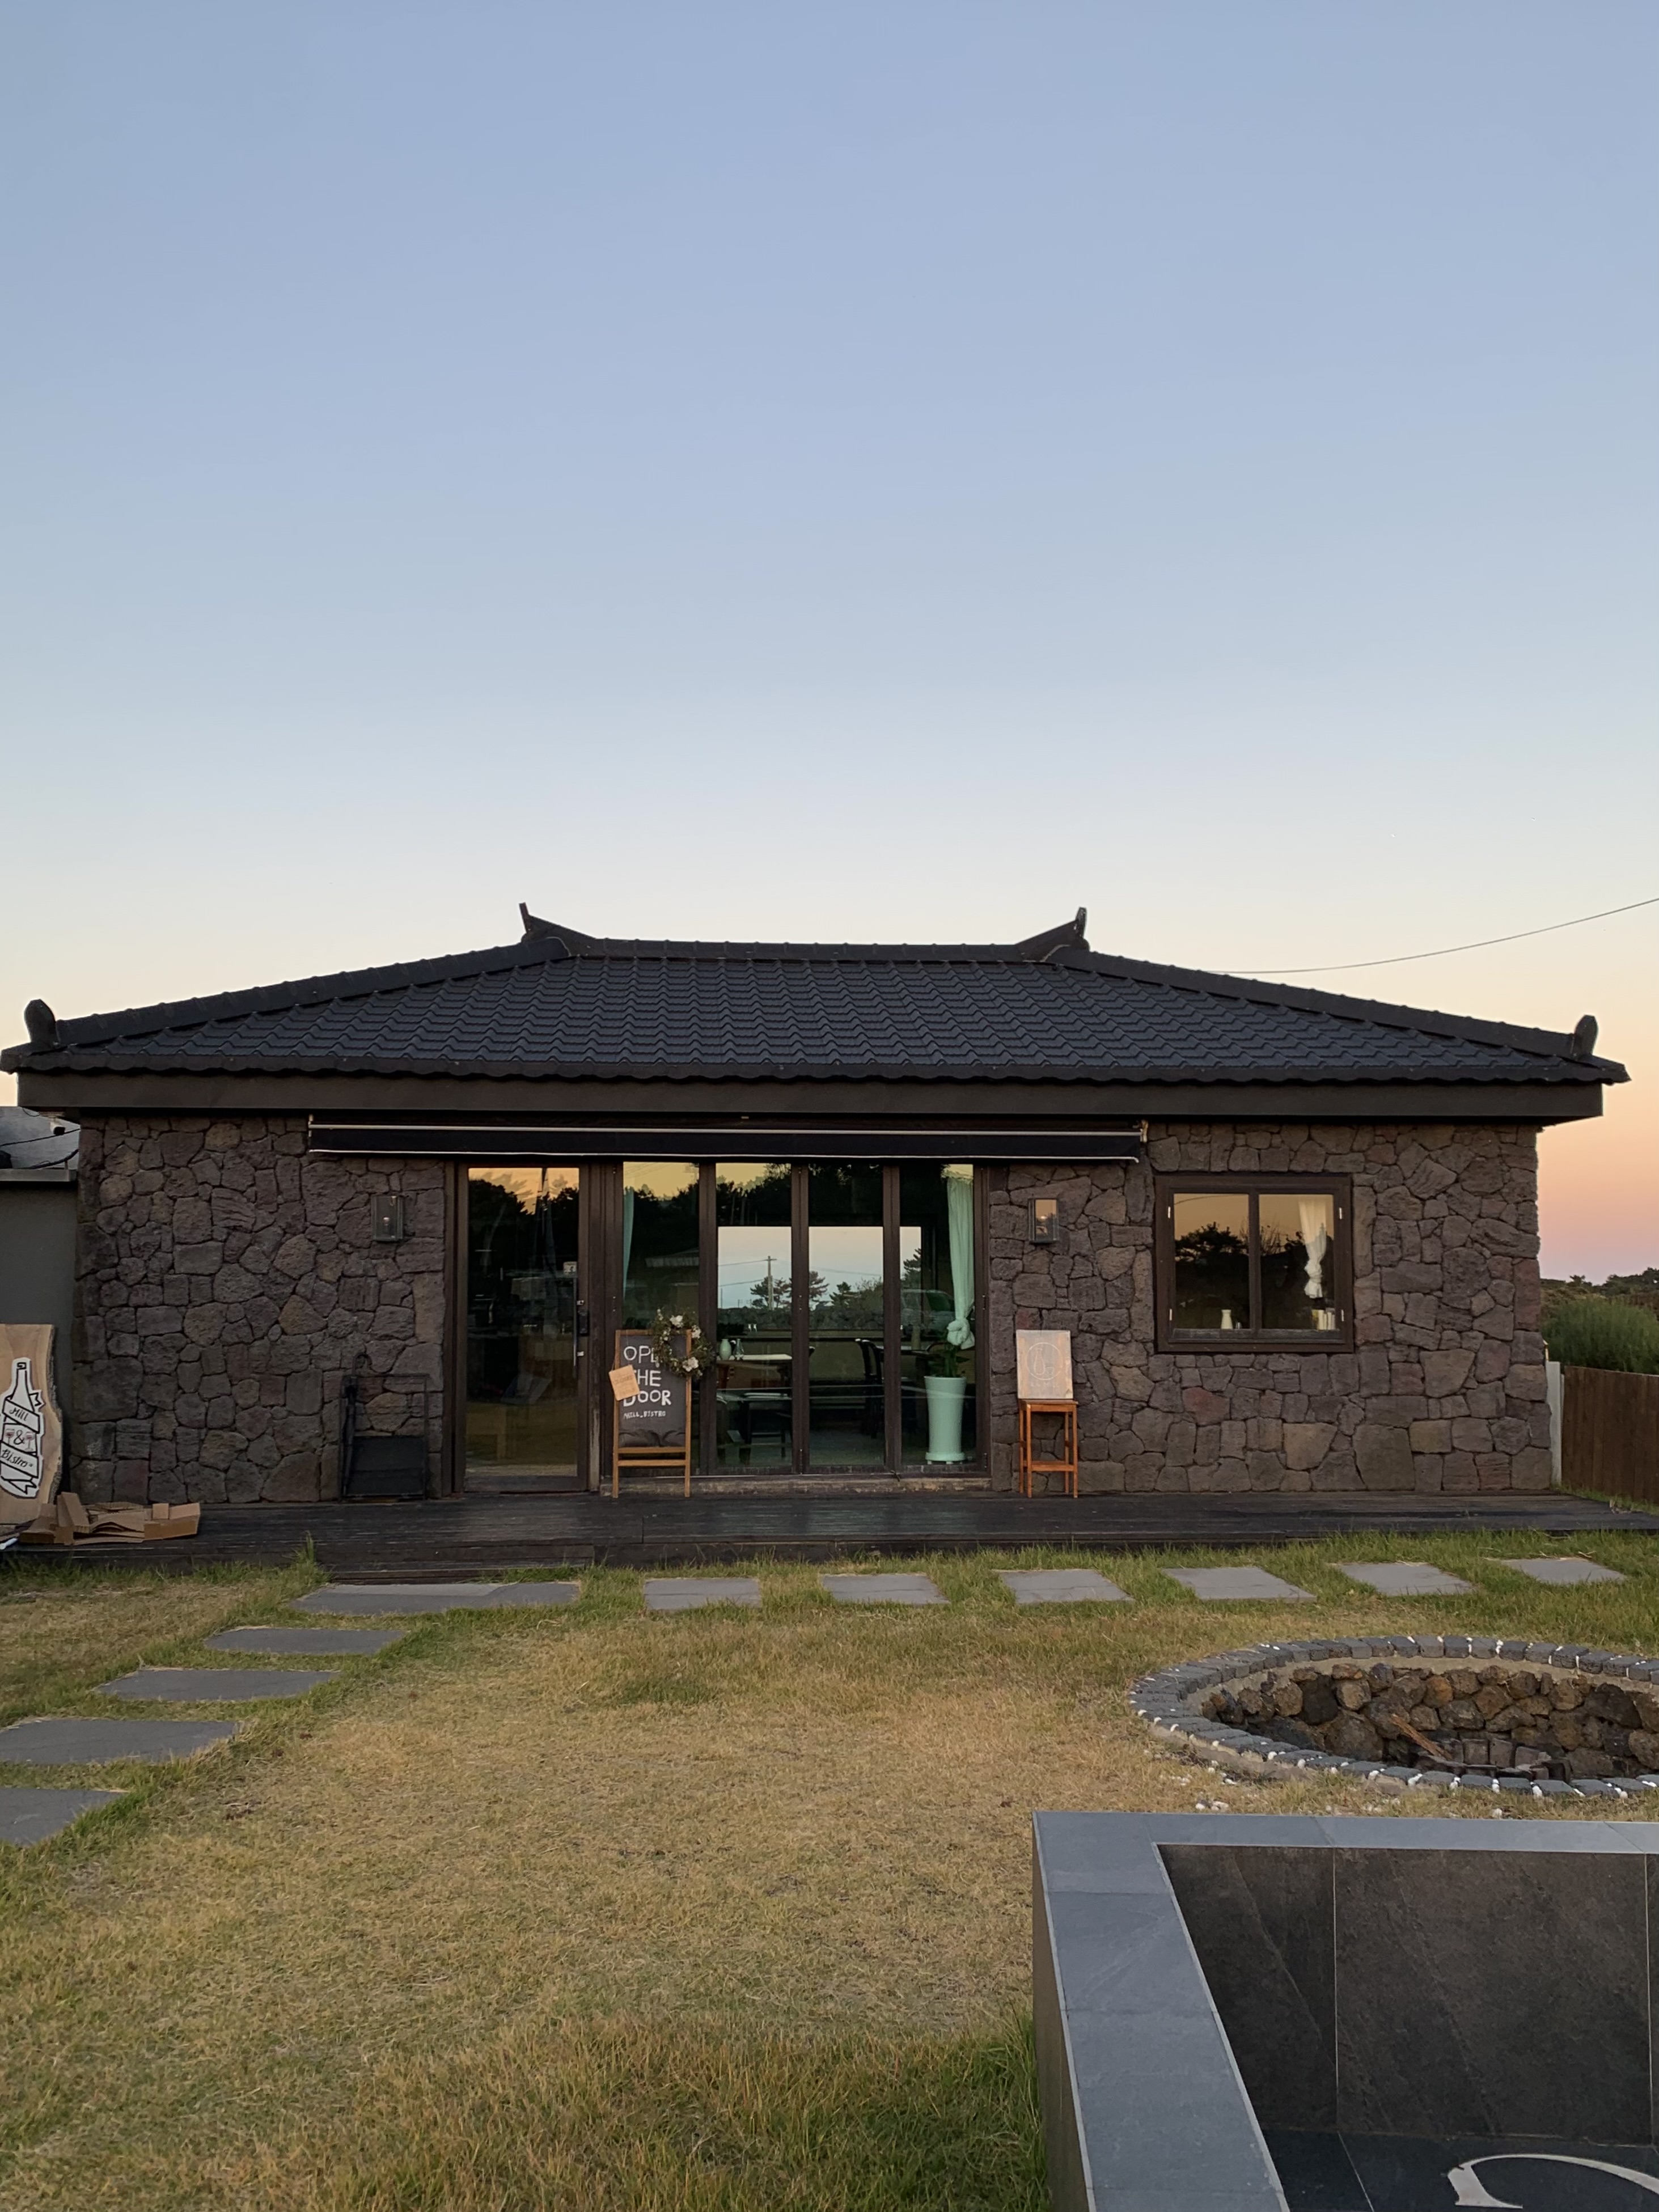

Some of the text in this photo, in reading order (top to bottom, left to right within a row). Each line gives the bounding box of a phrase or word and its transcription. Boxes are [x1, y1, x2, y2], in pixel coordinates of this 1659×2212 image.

[634, 1369, 661, 1387] HE
[9, 1408, 28, 1421] Mill
[13, 1430, 25, 1445] &
[1, 1449, 28, 1468] Bistro
